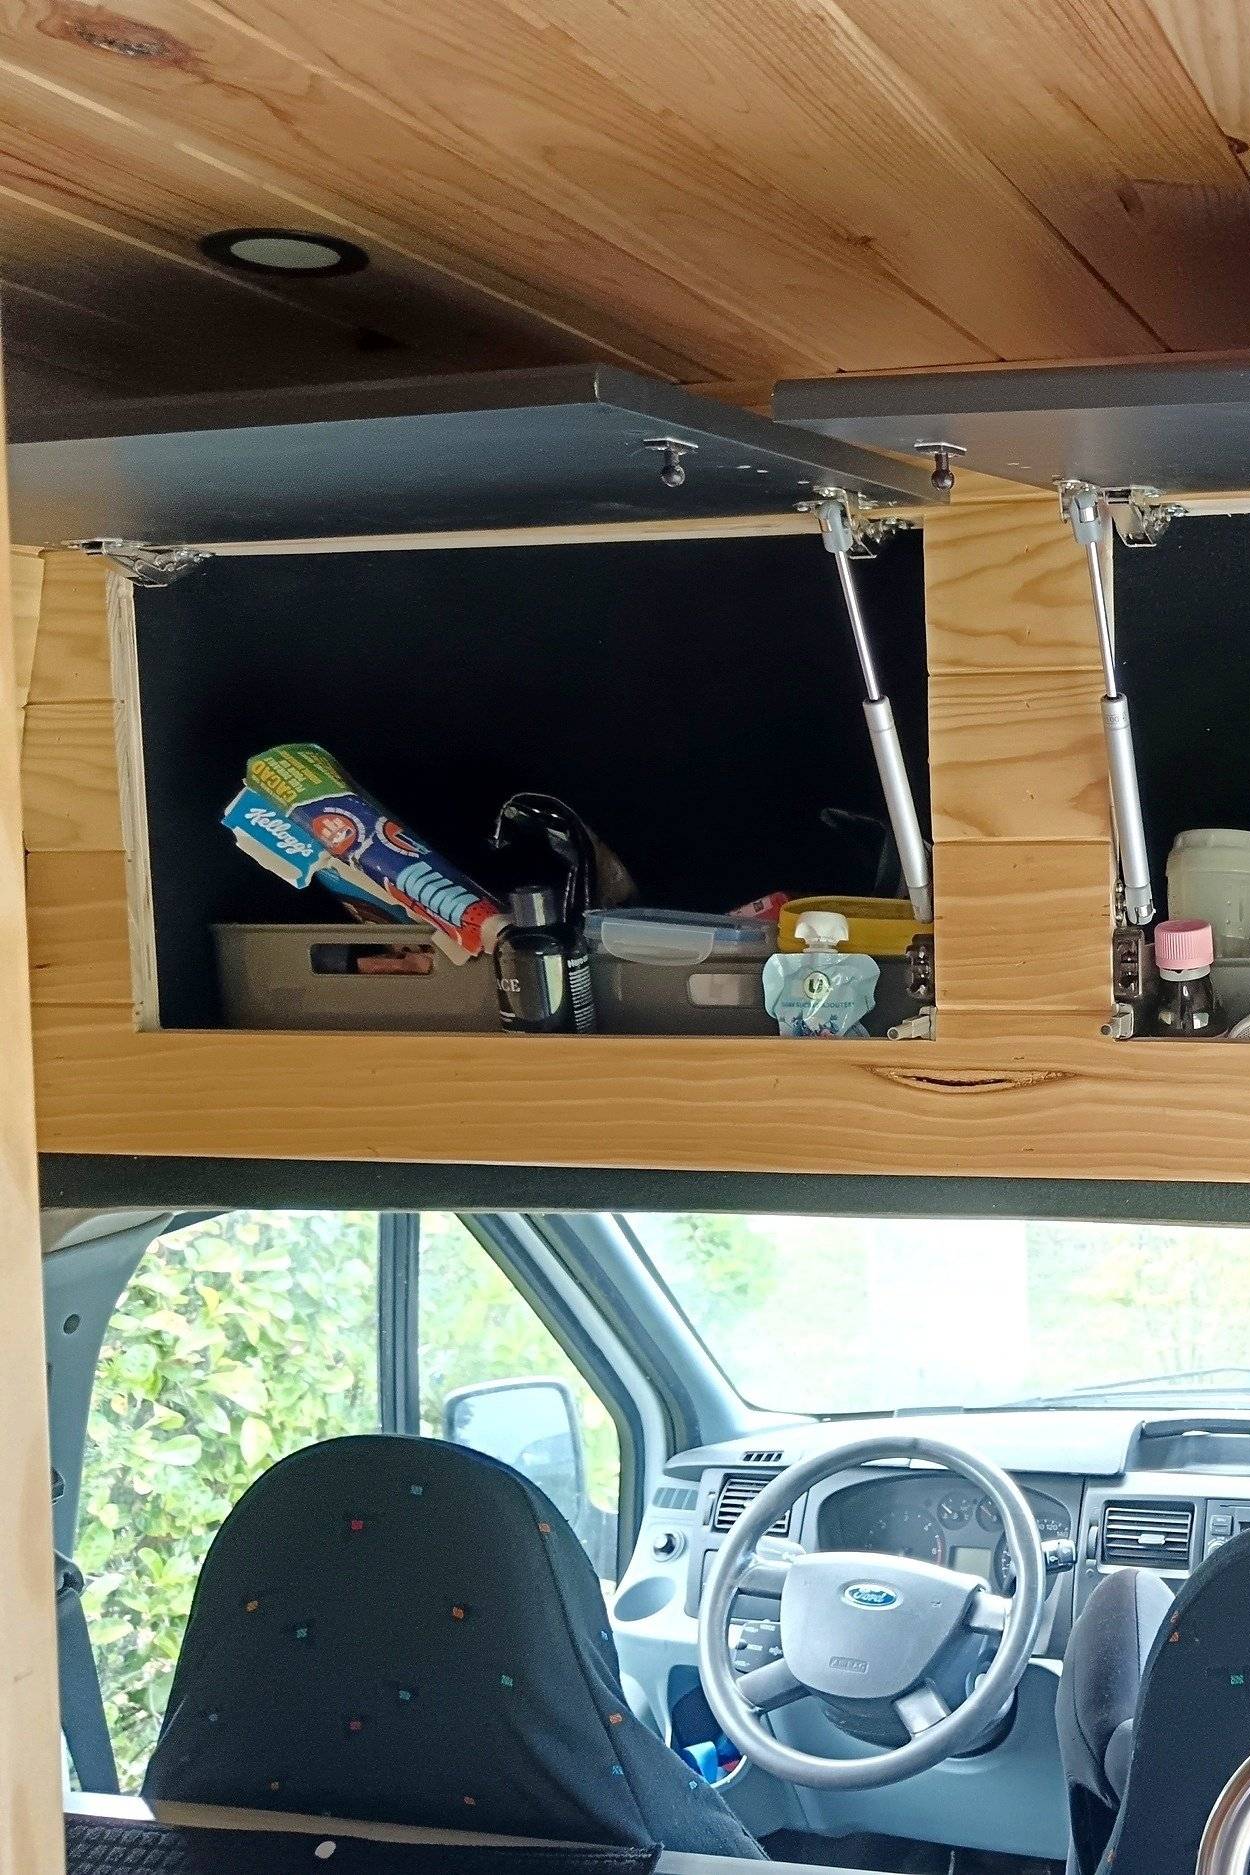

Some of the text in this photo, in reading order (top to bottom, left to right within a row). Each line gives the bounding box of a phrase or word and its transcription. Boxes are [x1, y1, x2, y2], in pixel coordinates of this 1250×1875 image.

[252, 760, 297, 803] CACAO
[244, 808, 313, 857] Kellogg's
[852, 1591, 887, 1603] Ford
